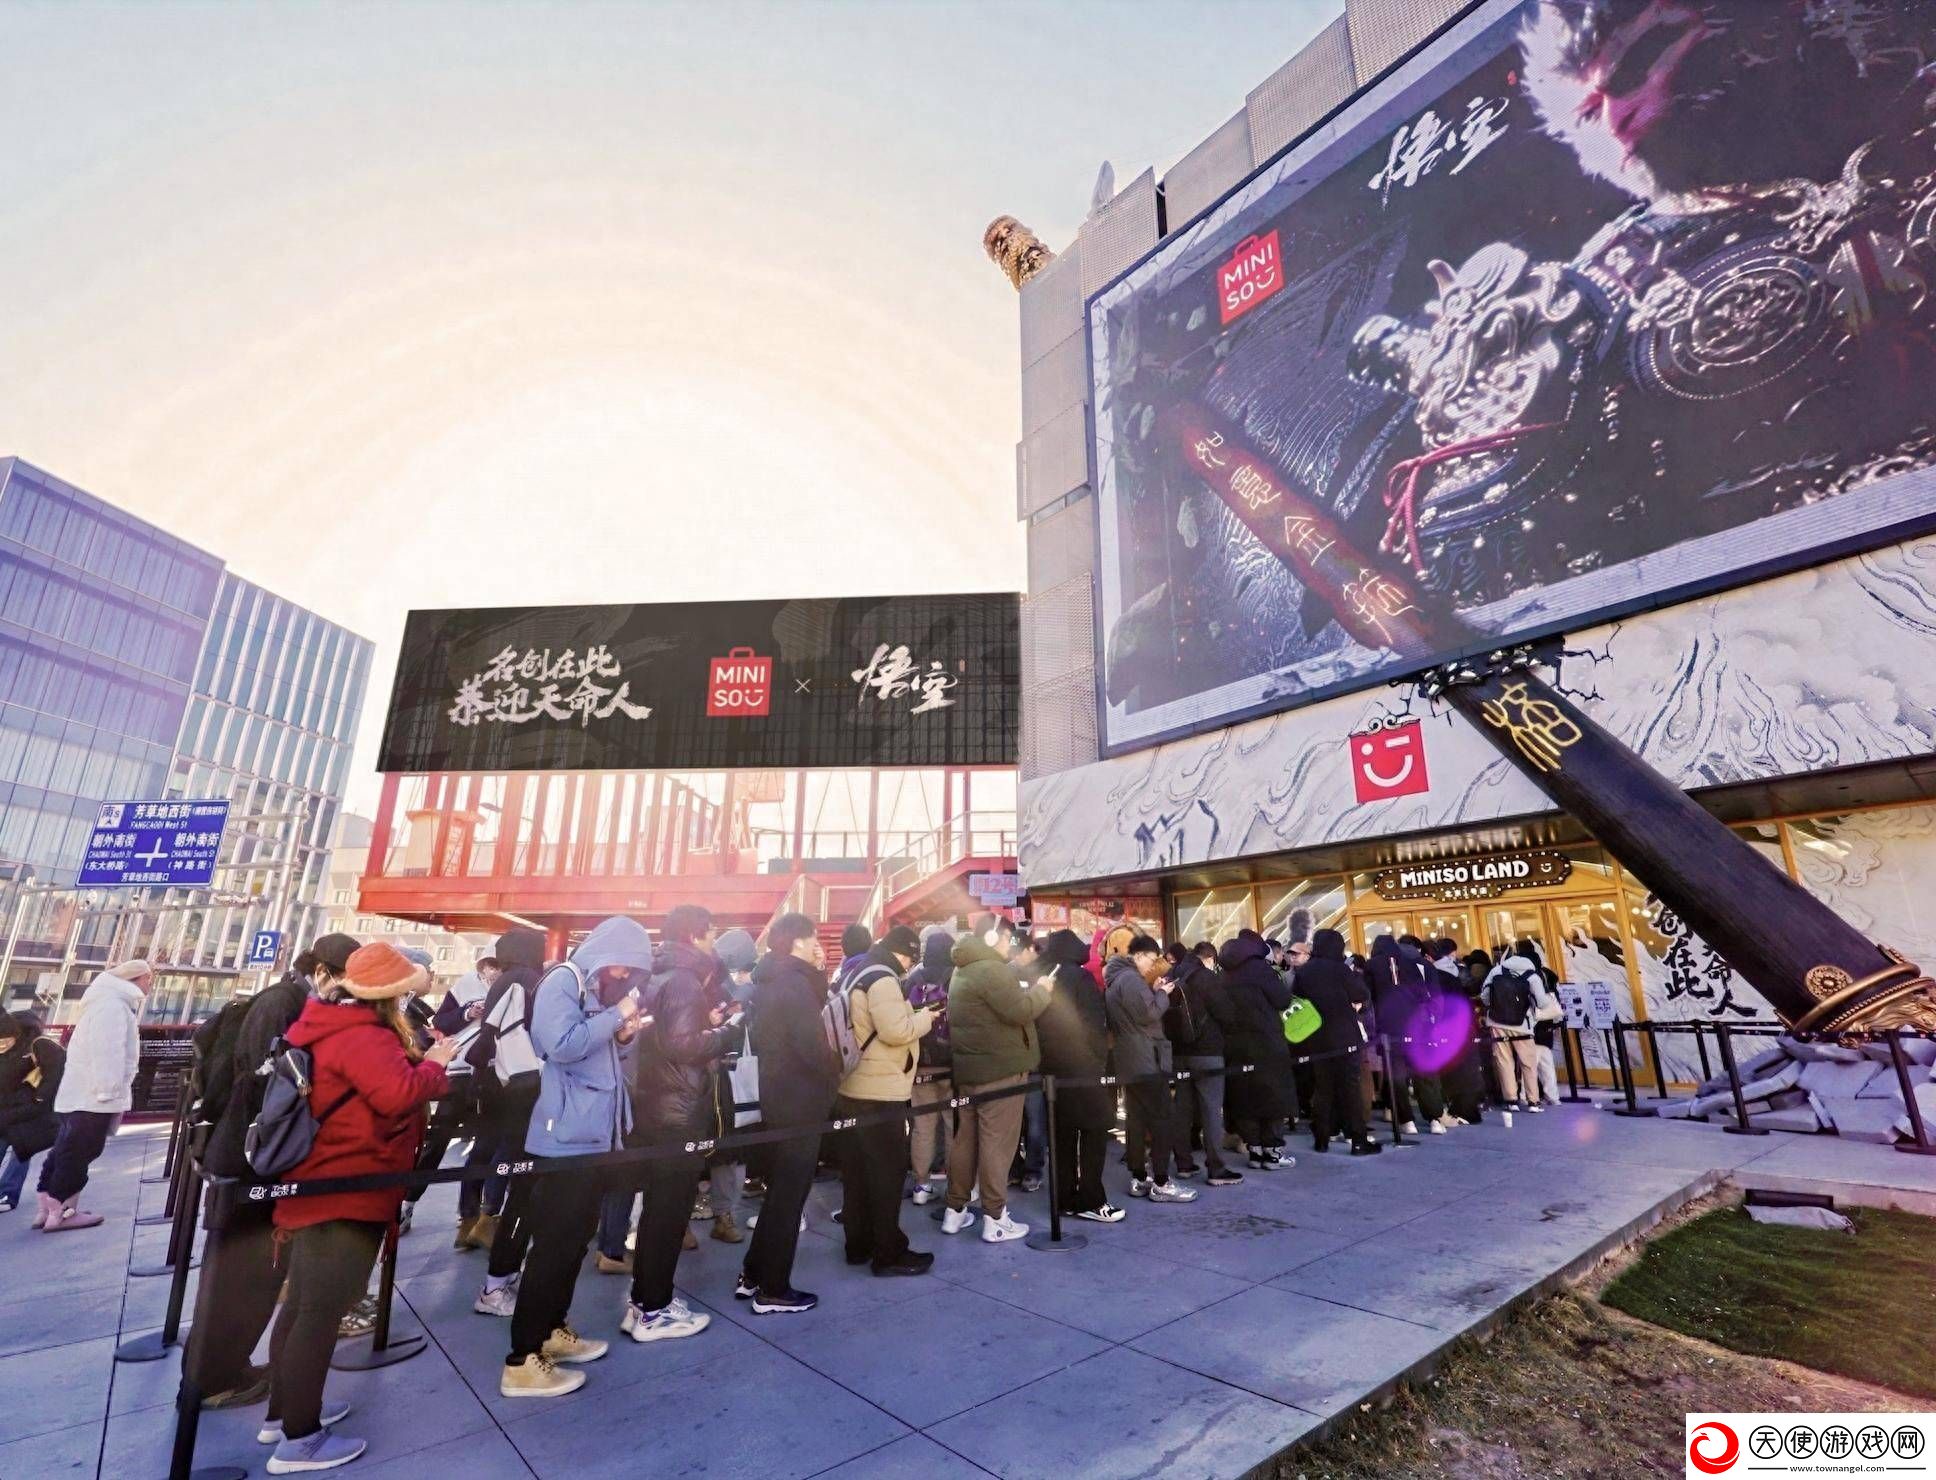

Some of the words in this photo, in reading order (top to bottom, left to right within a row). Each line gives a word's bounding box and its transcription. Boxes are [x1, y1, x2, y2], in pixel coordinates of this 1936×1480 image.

[1224, 243, 1273, 290] MINI
[482, 645, 621, 681] 名创在此
[716, 666, 766, 684] MINI
[448, 674, 653, 728] 恭迎天命人
[134, 804, 192, 819] 芳草地西街
[92, 833, 138, 848] 朝外南街
[174, 833, 219, 847] 朝外南街
[1401, 867, 1468, 888] MINISO
[1472, 860, 1529, 881] LAND
